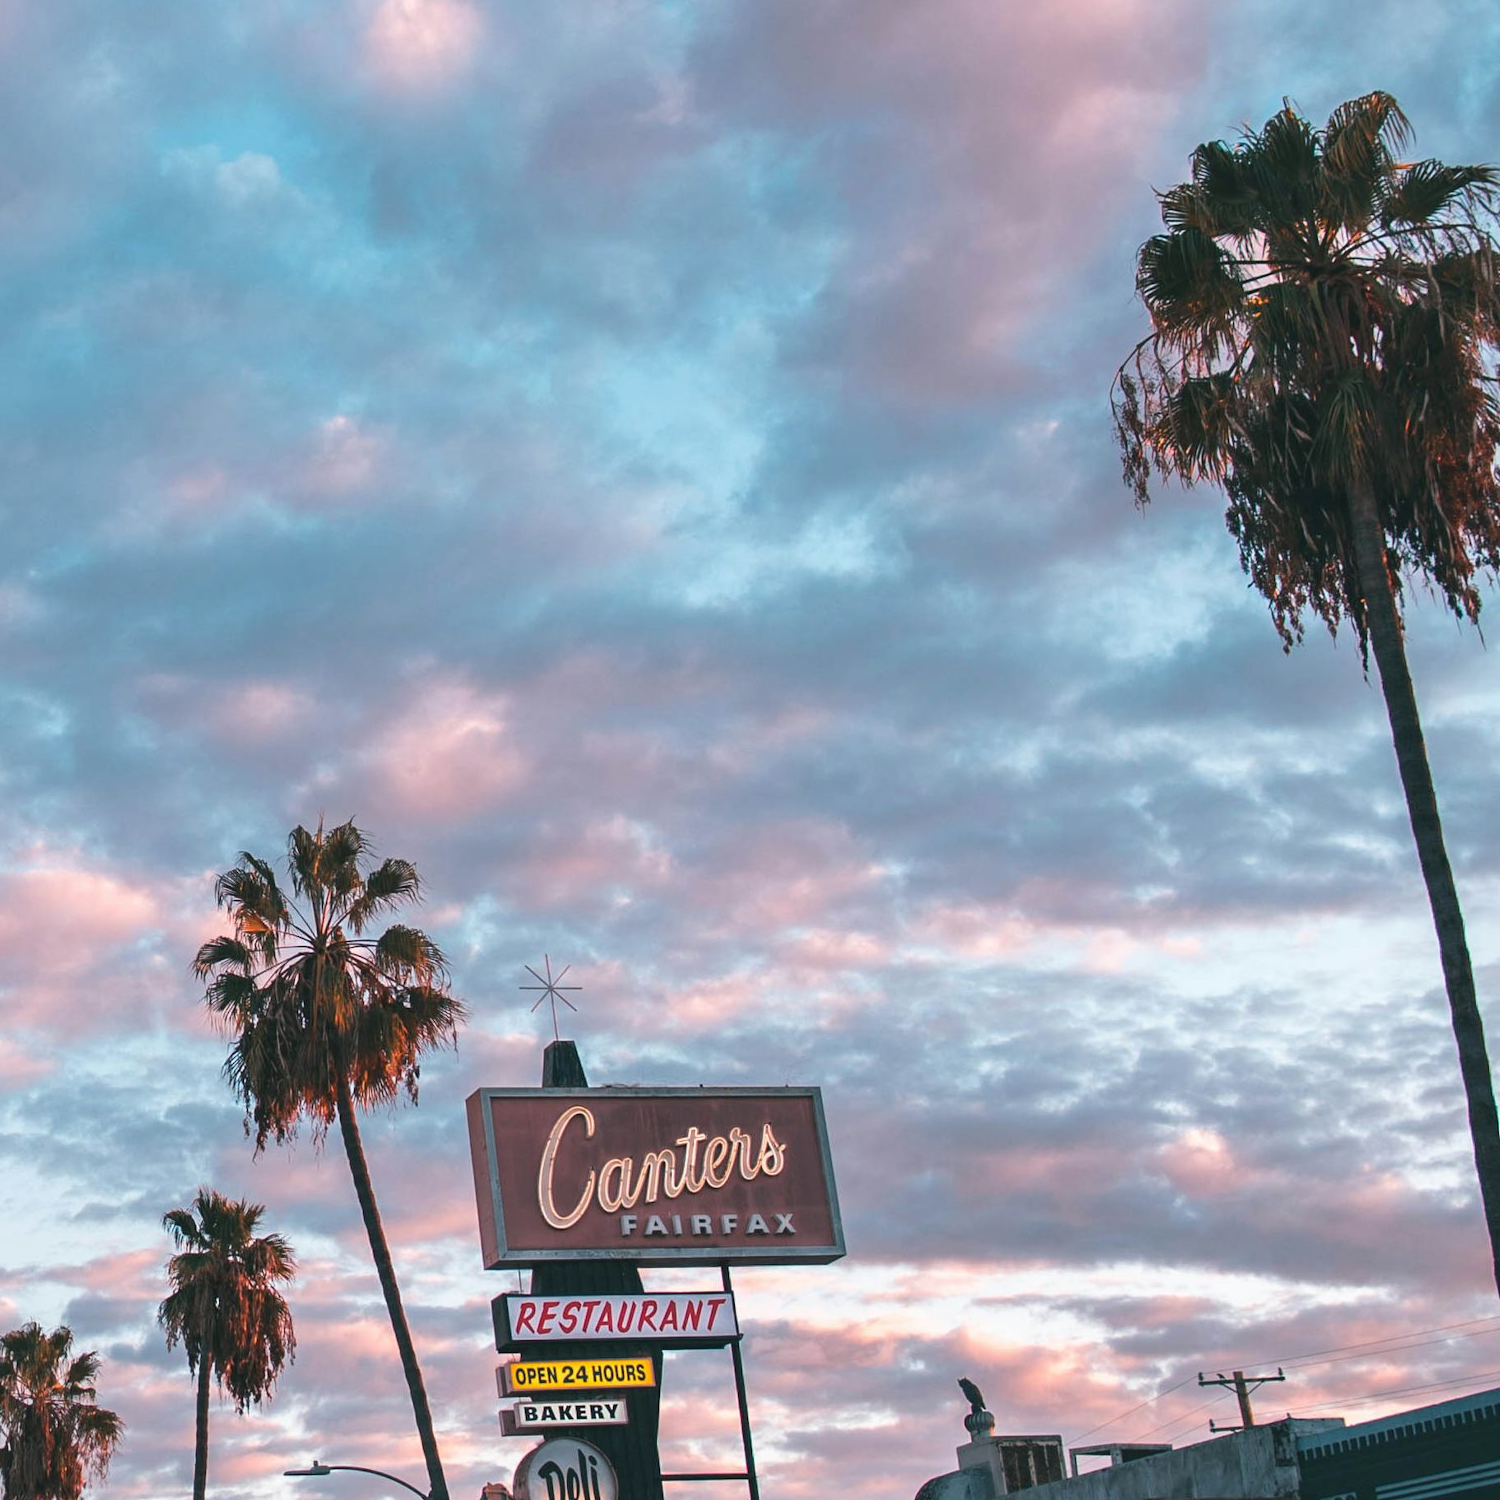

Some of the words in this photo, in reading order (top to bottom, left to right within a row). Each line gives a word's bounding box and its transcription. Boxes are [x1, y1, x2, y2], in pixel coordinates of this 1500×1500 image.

[537, 1106, 787, 1230] Canters
[620, 1212, 797, 1237] FAIRFAX
[515, 1298, 728, 1334] RESTAURANT
[515, 1366, 558, 1385] OPEN
[561, 1365, 589, 1384] 24
[593, 1363, 647, 1382] HOURS
[524, 1403, 619, 1422] BAKERY
